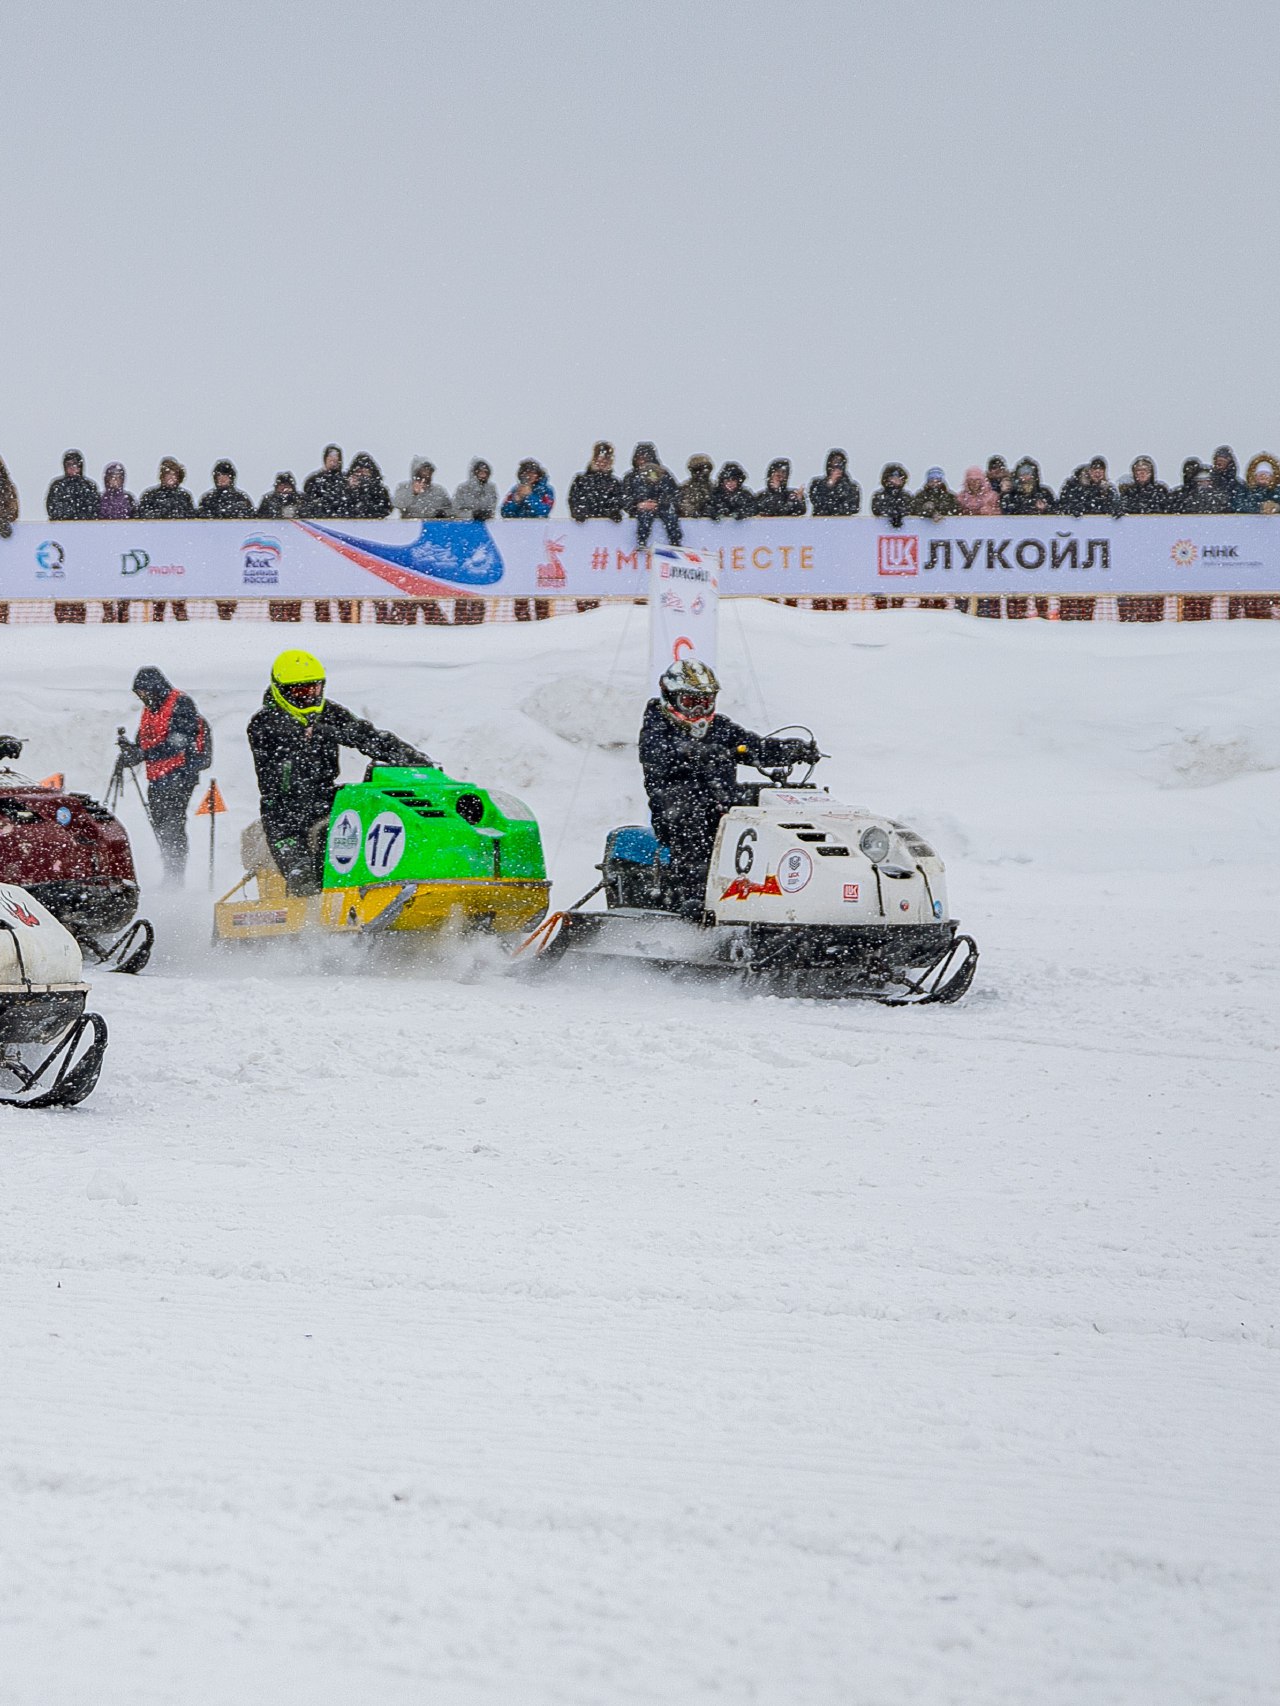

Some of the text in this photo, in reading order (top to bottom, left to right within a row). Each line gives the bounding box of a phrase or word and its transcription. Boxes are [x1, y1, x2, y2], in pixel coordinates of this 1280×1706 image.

[923, 531, 1110, 570] ЛУКОЙЛ
[1202, 545, 1239, 557] ННК
[367, 823, 403, 867] 17
[734, 827, 758, 875] 6
